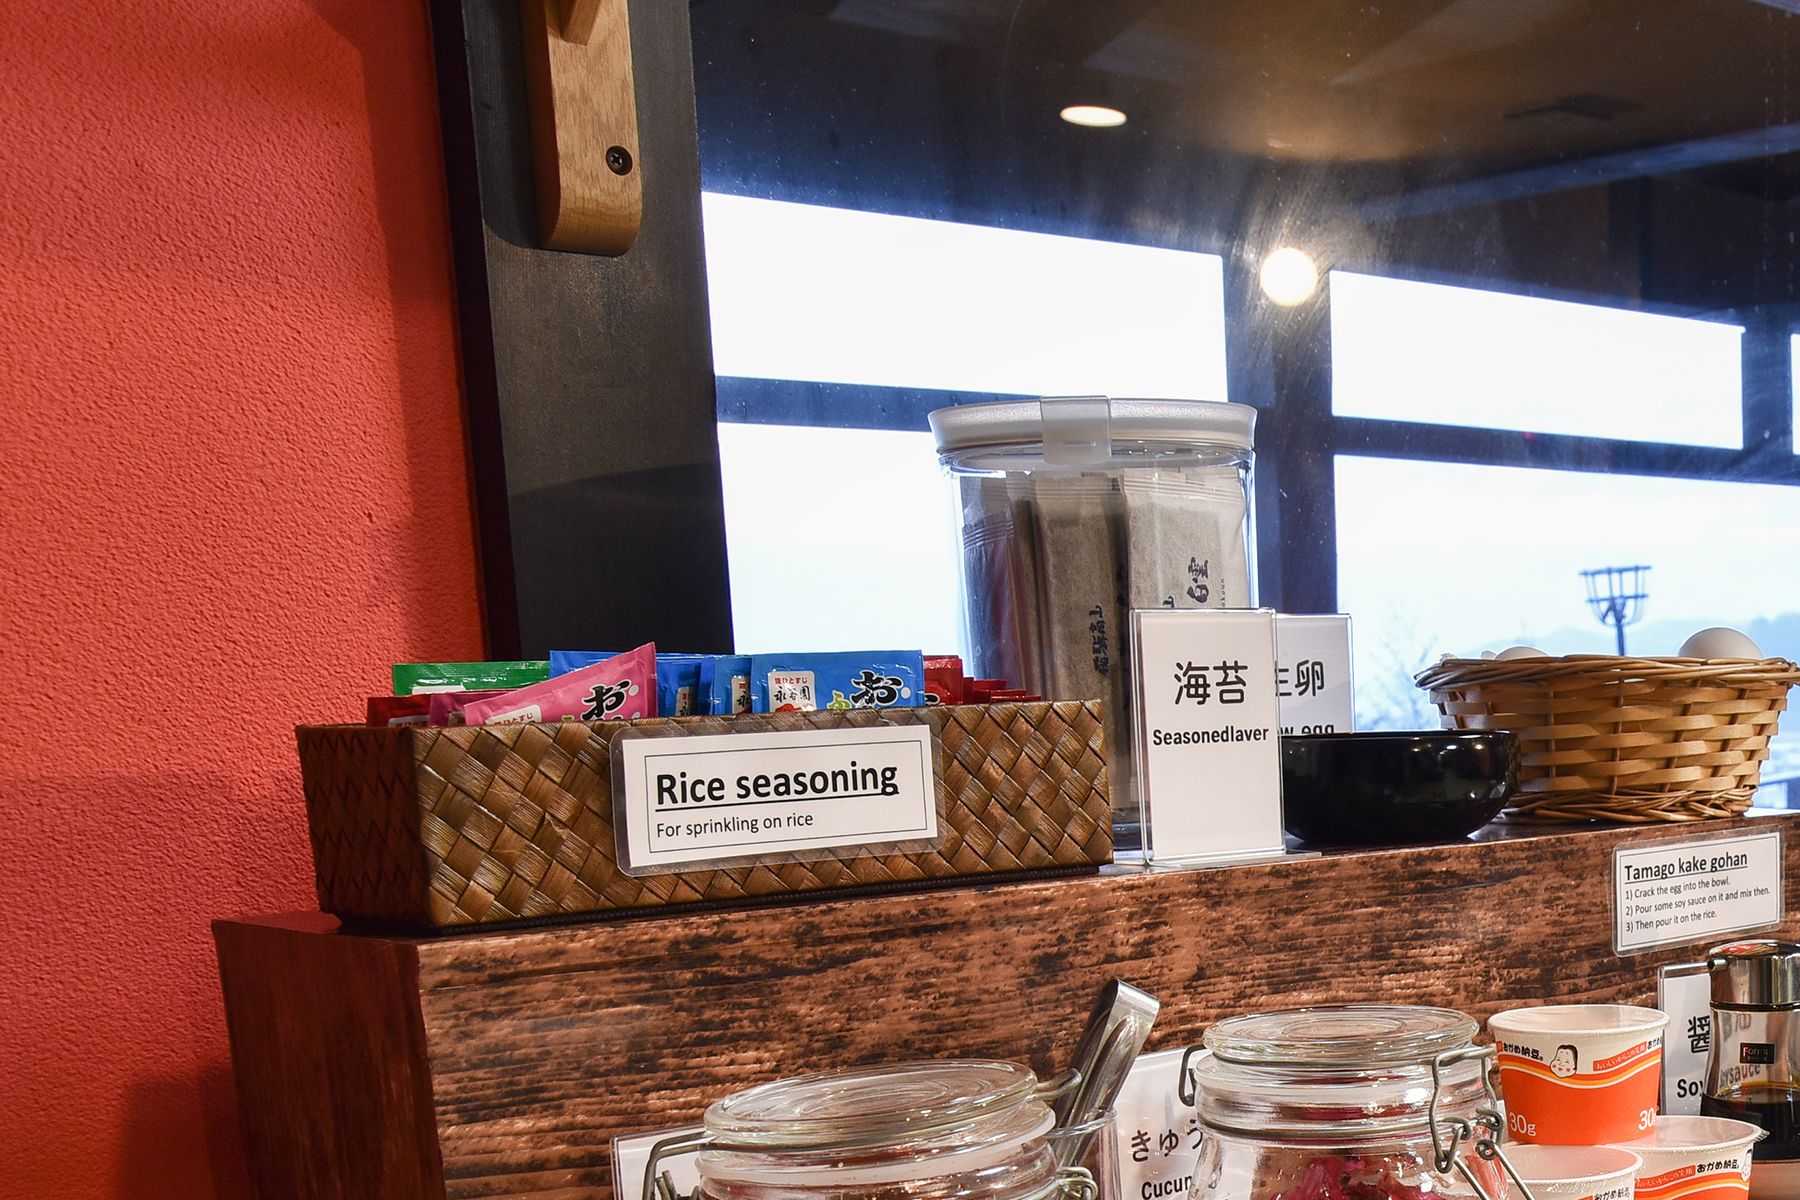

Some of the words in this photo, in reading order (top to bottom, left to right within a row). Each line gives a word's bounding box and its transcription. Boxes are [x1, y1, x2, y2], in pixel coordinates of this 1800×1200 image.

[1174, 660, 1248, 705] 海苔
[1153, 725, 1269, 746] Seasonedlaver
[657, 771, 725, 805] Rice
[737, 761, 899, 799] seasoning
[657, 822, 682, 838] For
[686, 816, 759, 838] sprinkling
[763, 817, 782, 830] on
[787, 812, 814, 828] rice
[1624, 863, 1675, 881] Tamago
[1678, 856, 1707, 874] kake
[1710, 852, 1748, 873] gohan
[1625, 890, 1633, 901] 1)
[1634, 888, 1655, 900] Crack
[1656, 886, 1669, 896] the
[1669, 884, 1682, 895] egg
[1683, 881, 1697, 892] into
[1698, 879, 1710, 890] the
[1711, 876, 1731, 888] bowl.
[1625, 906, 1634, 917] 2)
[1635, 903, 1652, 915] Pour
[1654, 901, 1673, 913] some
[1674, 899, 1687, 909] soy
[1687, 896, 1707, 907] sauce
[1707, 894, 1718, 904] on
[1718, 892, 1724, 902] it
[1725, 889, 1739, 900] and
[1739, 888, 1753, 899] mix
[1753, 886, 1770, 898] then.
[1626, 922, 1634, 933] 3)
[1635, 919, 1654, 931] Then
[1655, 917, 1672, 930] pour
[1673, 915, 1679, 925] it
[1680, 914, 1690, 923] on
[1690, 911, 1702, 922] the
[1702, 909, 1718, 920] rice.
[1509, 1111, 1537, 1137] 30g
